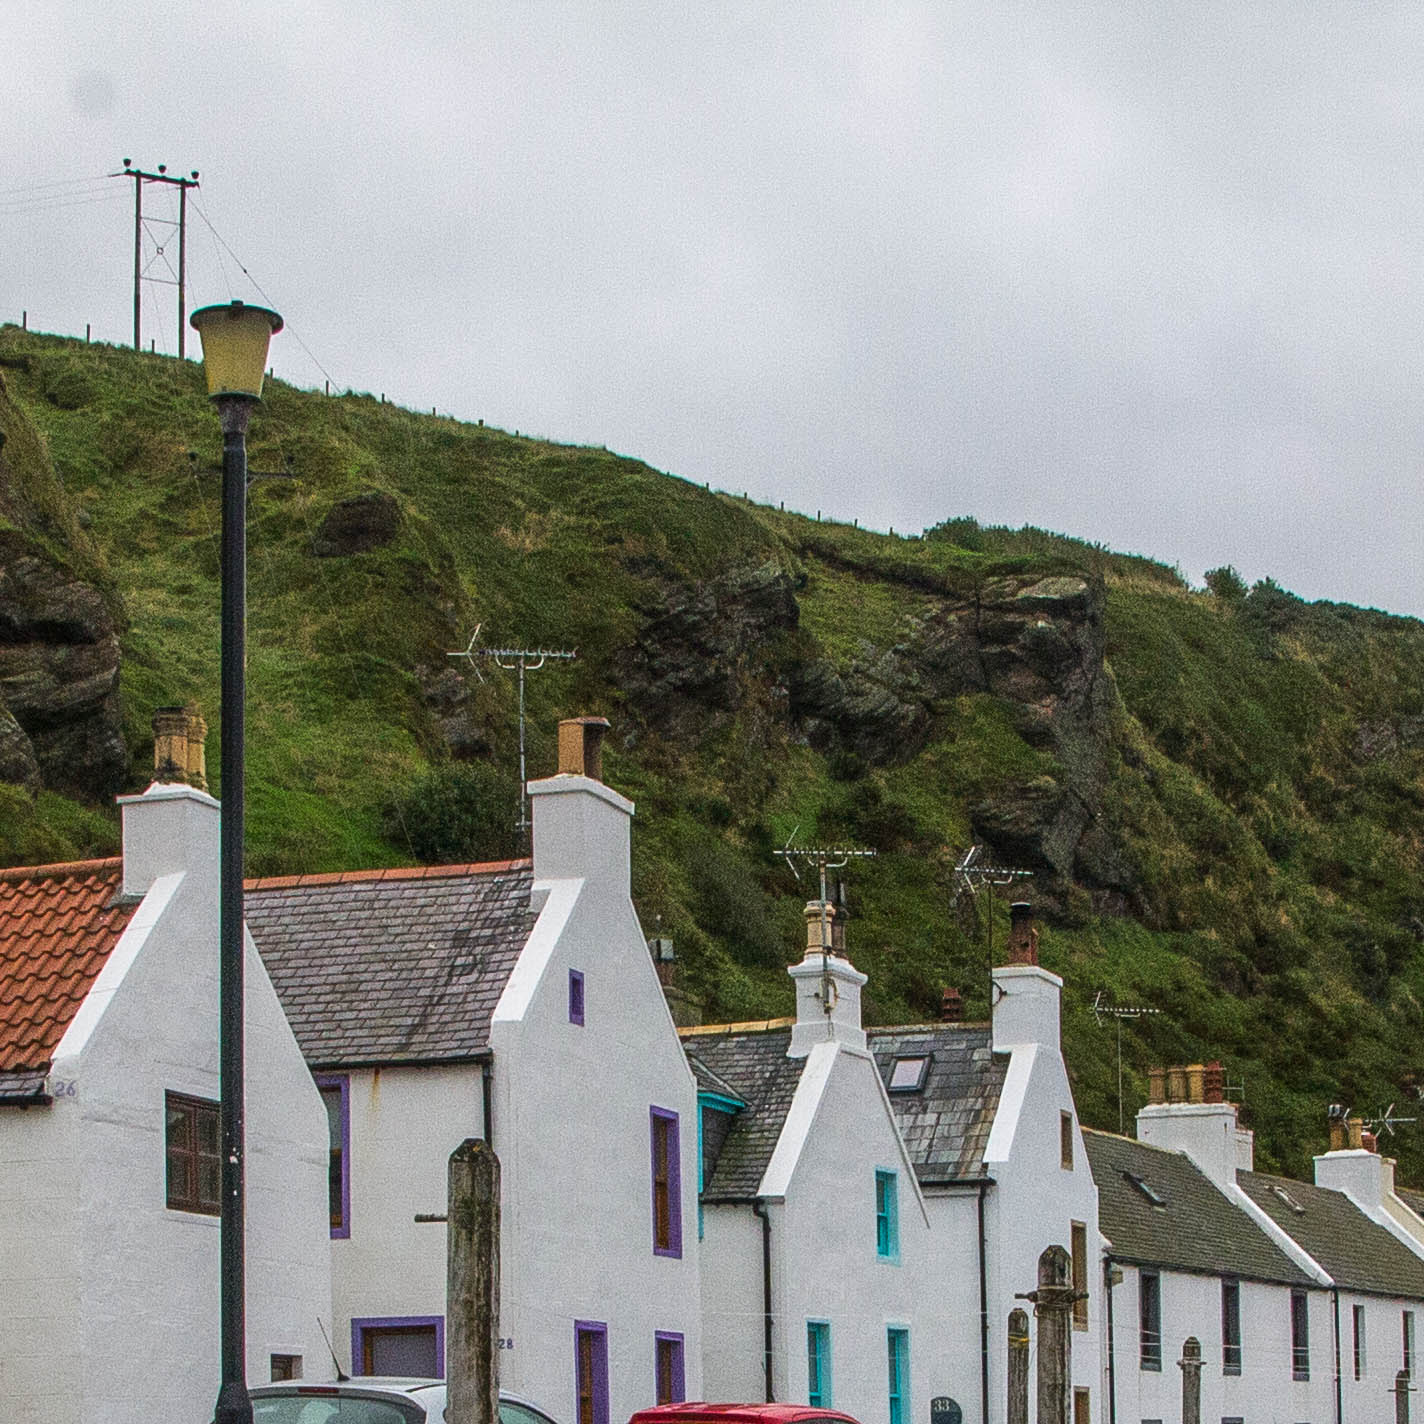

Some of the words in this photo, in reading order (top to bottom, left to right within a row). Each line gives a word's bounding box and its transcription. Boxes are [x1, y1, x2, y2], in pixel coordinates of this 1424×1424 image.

[55, 1080, 77, 1097] 26
[498, 1338, 514, 1350] 28
[934, 1399, 950, 1412] 33
